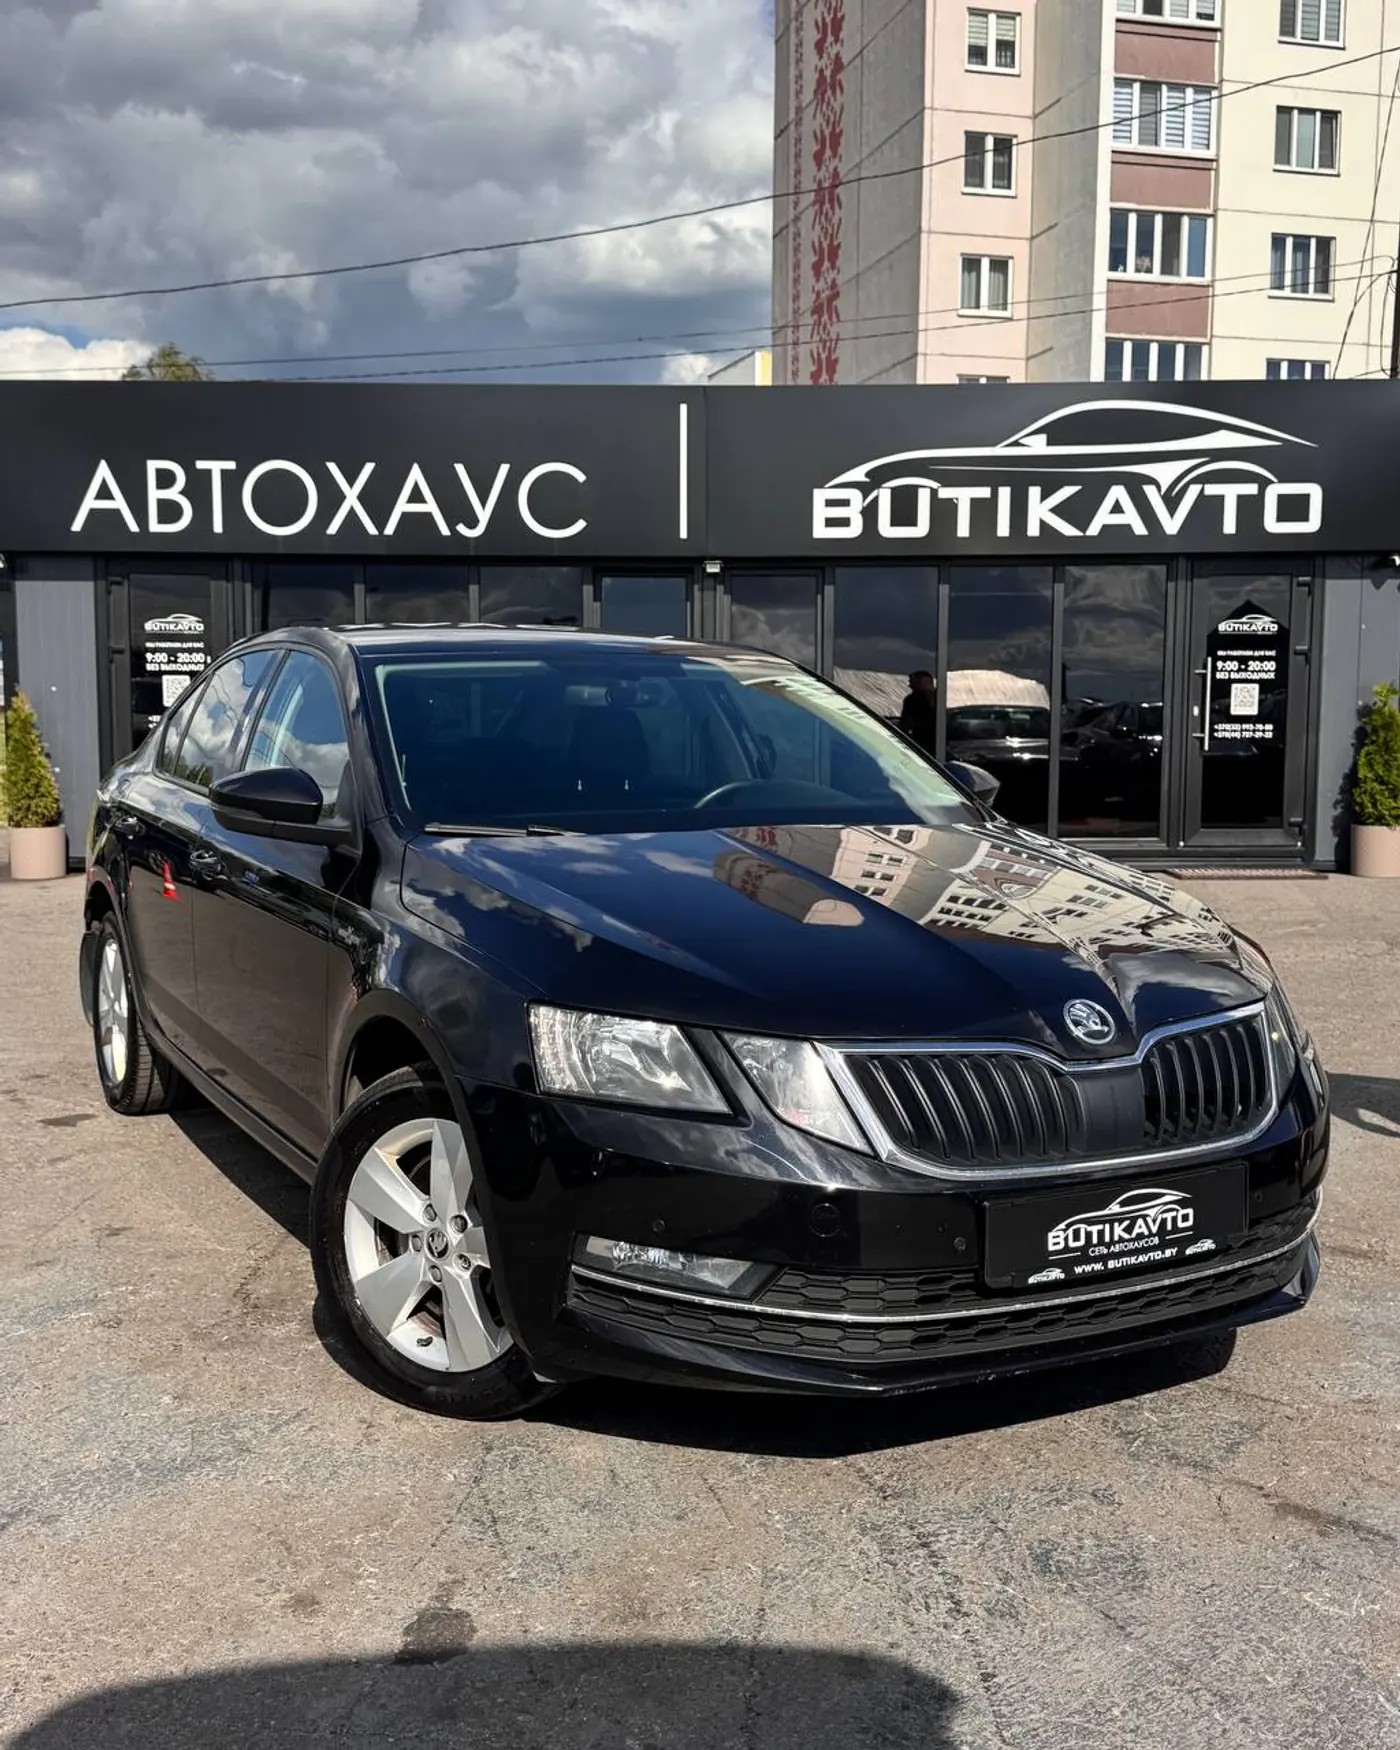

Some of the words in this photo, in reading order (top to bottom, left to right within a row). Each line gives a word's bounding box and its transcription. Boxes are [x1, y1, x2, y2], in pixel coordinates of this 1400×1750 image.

[71, 459, 588, 540] АВТОХАУС
[811, 482, 1323, 540] BUTIKAVTO
[145, 652, 168, 663] 9:00
[177, 653, 205, 663] 20:00
[1216, 660, 1239, 671] 9:00
[1247, 661, 1276, 671] 20:00
[1216, 672, 1229, 680] БЕЗ
[1047, 1208, 1194, 1252] BUTIKAVTO
[1089, 1244, 1108, 1257] СЕТЬ
[1109, 1236, 1159, 1253] АВТОХАУСОВ
